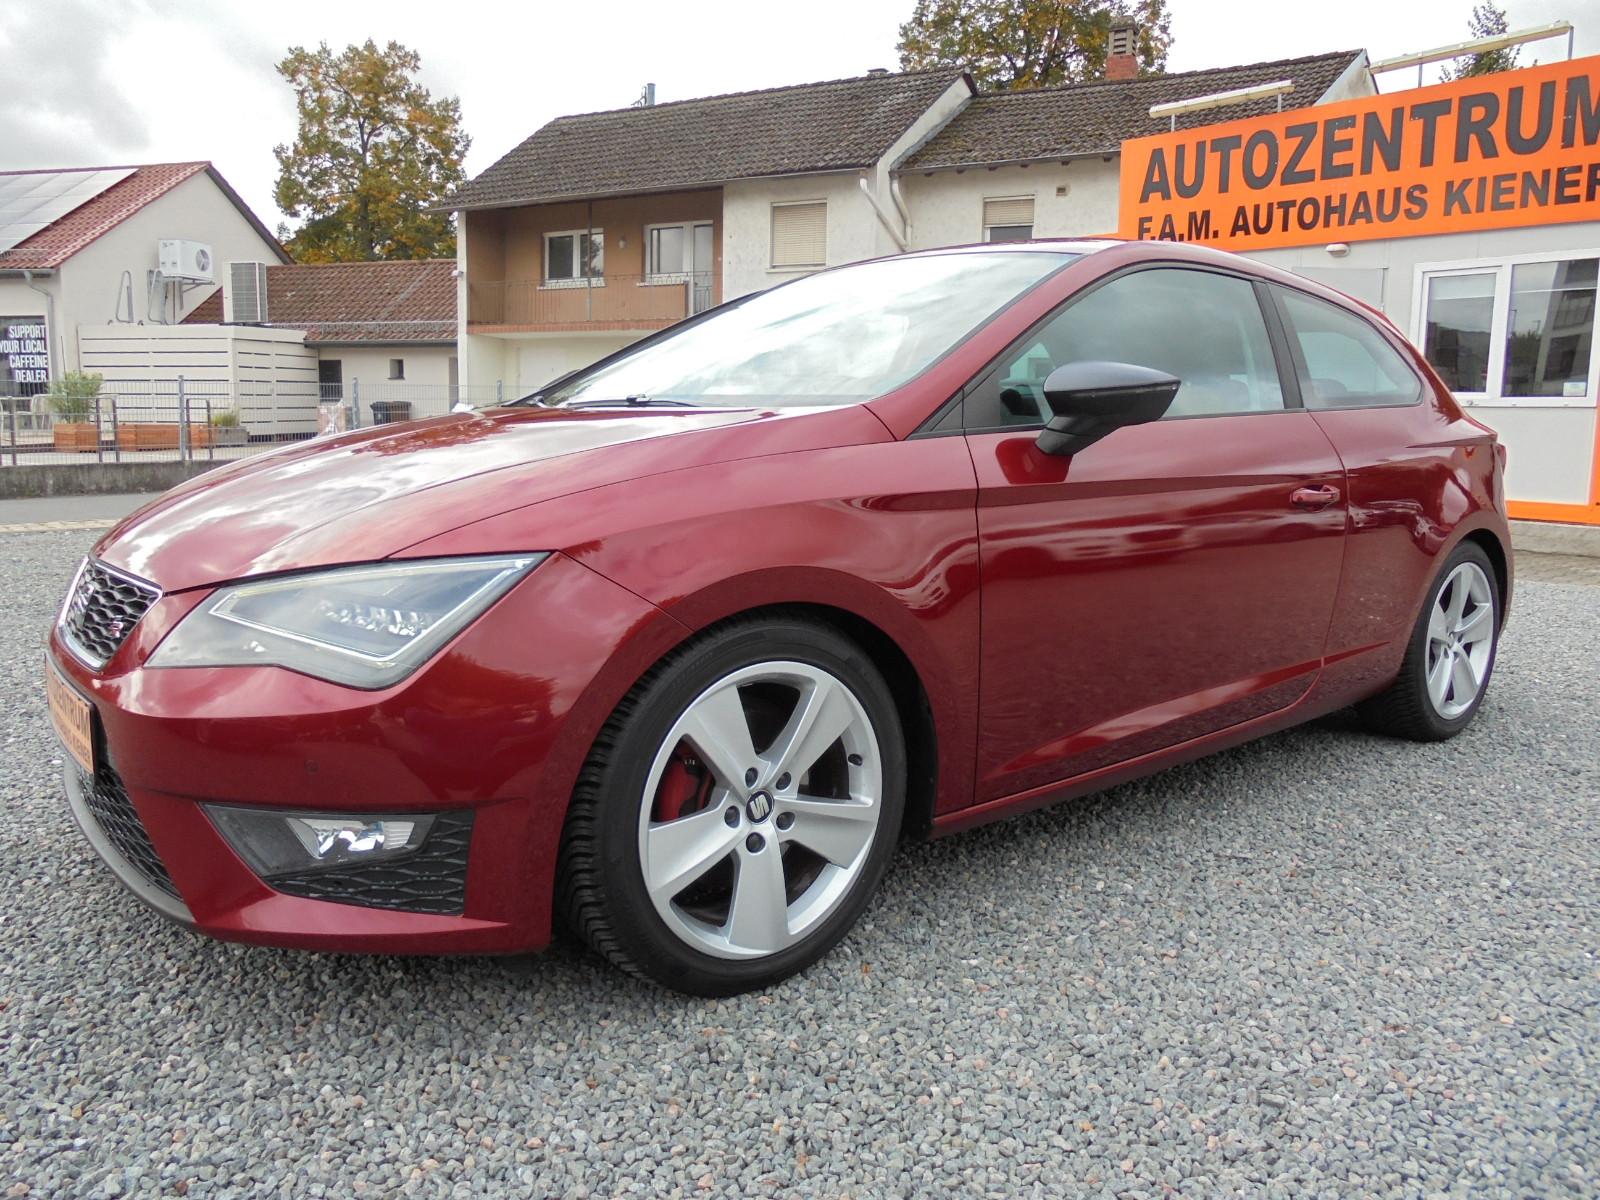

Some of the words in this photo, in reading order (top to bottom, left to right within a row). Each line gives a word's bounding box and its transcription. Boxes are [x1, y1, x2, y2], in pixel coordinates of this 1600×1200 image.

[1139, 75, 1600, 204] AUTOZENTRUM
[1137, 209, 1219, 242] F.A.M.
[1230, 184, 1428, 237] AUTOHAUS
[8, 325, 46, 338] SUPPORT
[21, 340, 48, 353] LOCAL
[9, 355, 49, 368] CAFFEINE
[15, 370, 47, 383] DEALER
